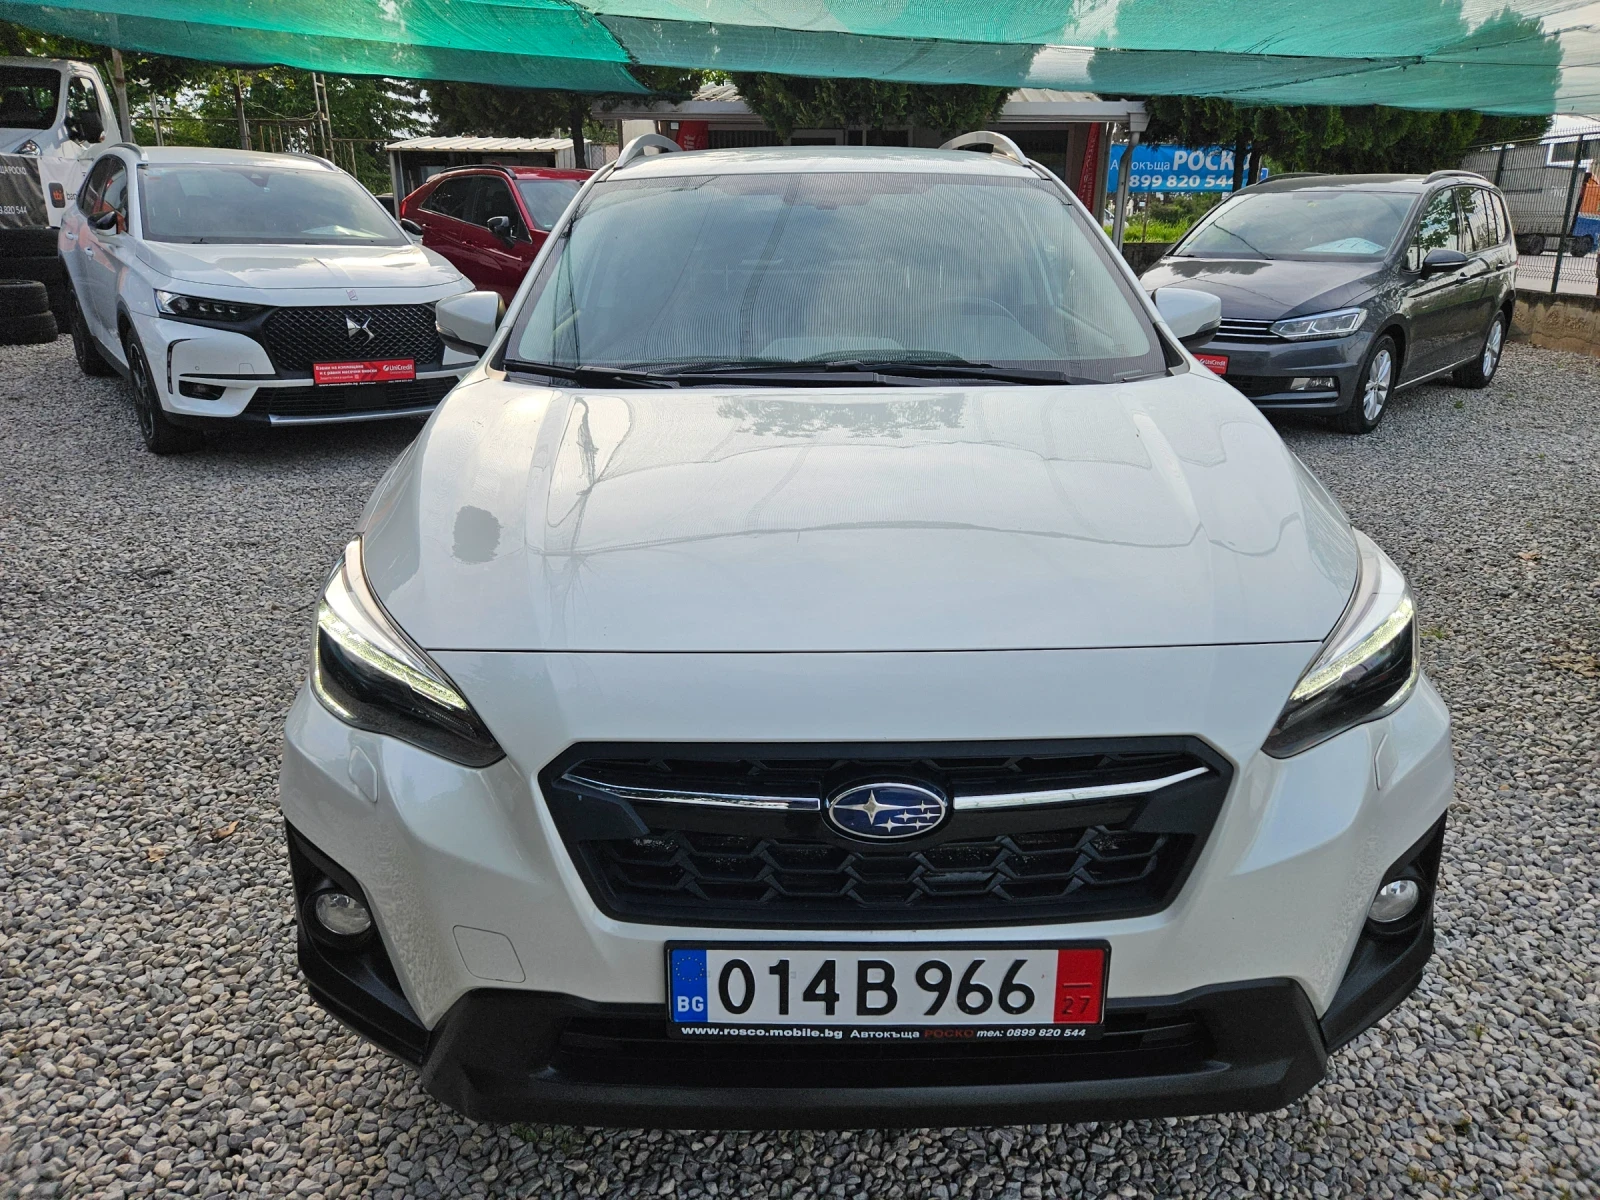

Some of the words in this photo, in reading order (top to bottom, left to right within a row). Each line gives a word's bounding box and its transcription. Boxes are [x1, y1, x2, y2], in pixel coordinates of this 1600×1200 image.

[1110, 159, 1170, 172] Аокъща
[1166, 175, 1200, 187] 820
[718, 958, 840, 1016] 014
[856, 960, 898, 1016] B
[915, 959, 1035, 1016] 966
[676, 996, 705, 1013] BG
[1062, 996, 1092, 1014] 27
[681, 1026, 843, 1040] www.rosco.mobile.bg
[849, 1029, 920, 1039] Автокъща
[924, 1029, 974, 1038] РОСКО
[976, 1029, 1004, 1038] тел:
[1006, 1028, 1036, 1038] 0899
[1038, 1028, 1061, 1037] 820
[1063, 1028, 1087, 1037] 544
